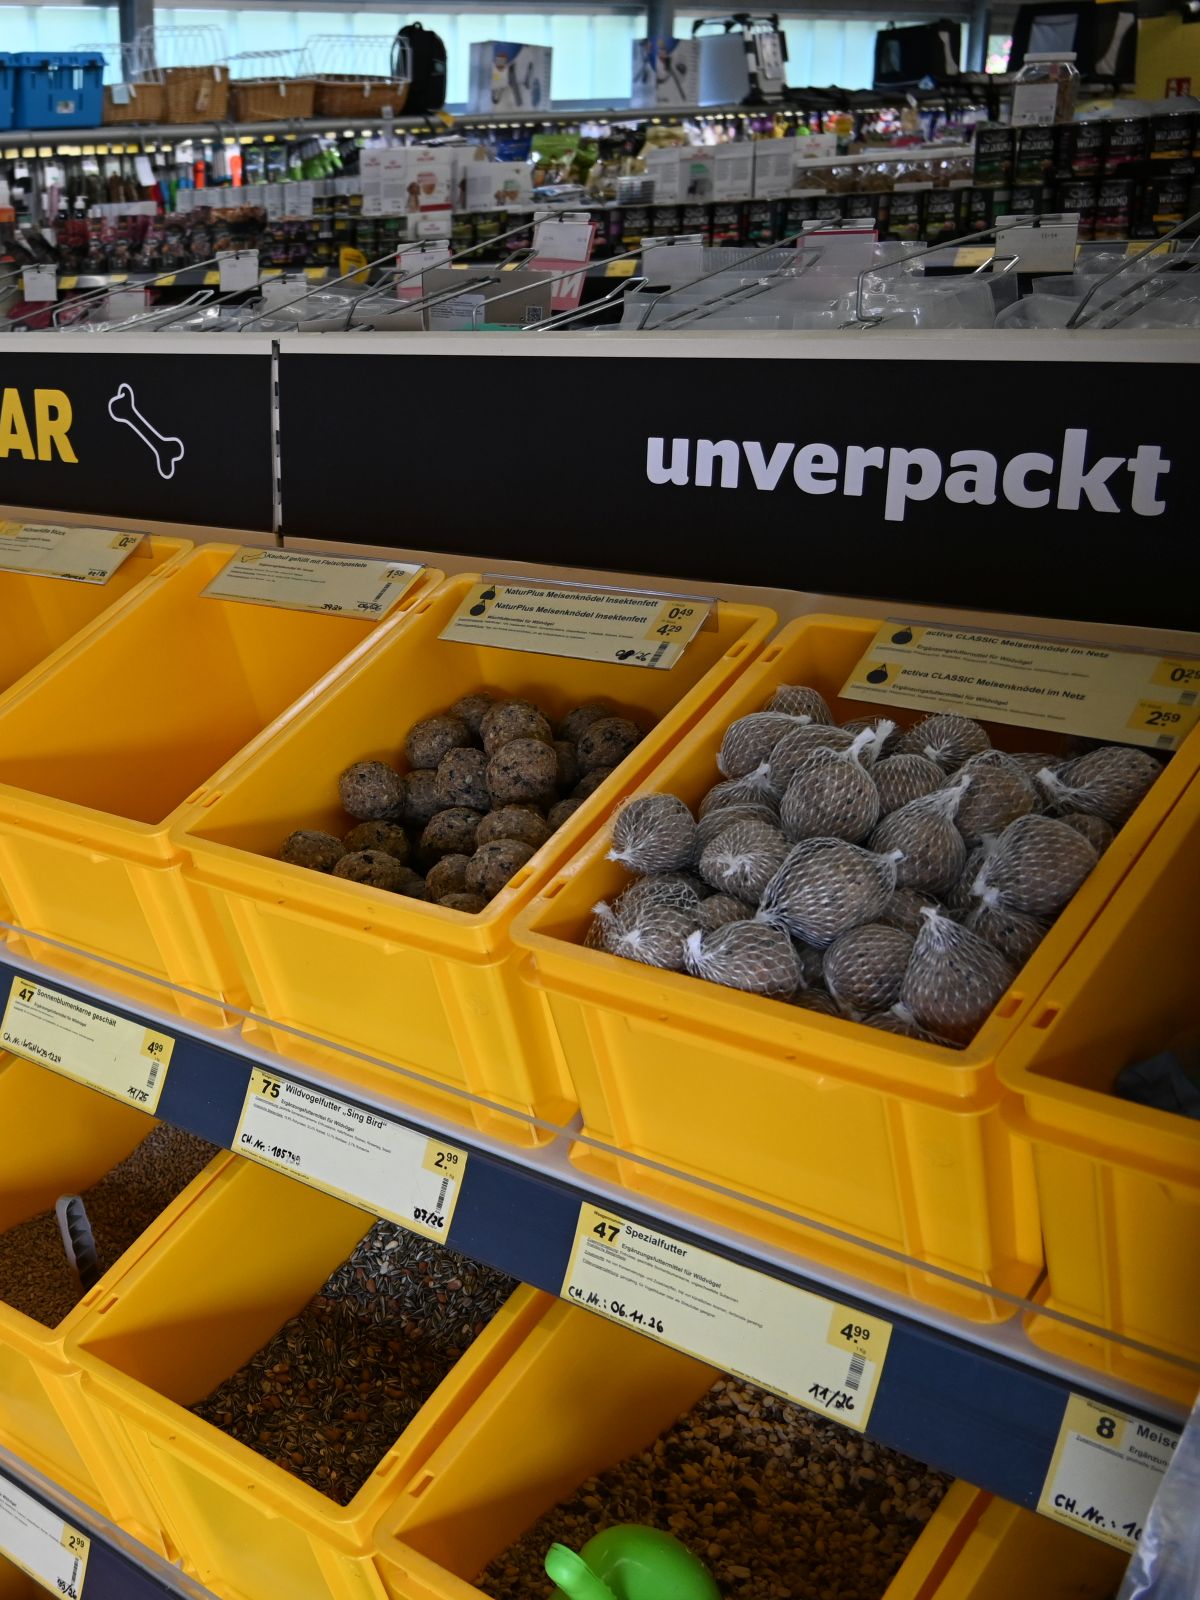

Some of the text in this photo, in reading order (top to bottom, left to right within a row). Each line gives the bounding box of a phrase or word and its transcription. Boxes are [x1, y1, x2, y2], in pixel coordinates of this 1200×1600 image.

[646, 428, 1171, 522] unverpackt
[505, 587, 659, 608] NaturPlus Meisenknödel Insektenfett
[494, 602, 648, 623] NaturPlus Meisenknödel Insektenfett
[668, 607, 694, 620] 0.49
[656, 624, 683, 636] 4.29
[924, 630, 954, 638] activa
[953, 633, 999, 644] CLASSIC
[999, 639, 1070, 653] Meisenknödel
[1085, 650, 1109, 658] Netz
[900, 667, 930, 678] activa
[929, 671, 975, 684] CLASSIC
[974, 678, 1046, 695] Meisenknödel
[1060, 691, 1086, 700] Netz
[1145, 711, 1181, 728] 2.59
[18, 988, 35, 1002] 47
[36, 988, 92, 1017] Sonnenblumenkerne
[91, 1011, 116, 1029] geschält
[147, 1041, 164, 1056] 4.99
[261, 1079, 282, 1098] 75
[284, 1083, 341, 1113] Wildvogelfutter
[434, 1152, 458, 1171] 2.99
[592, 1219, 620, 1244] 47
[623, 1224, 687, 1259] Spezialfutter
[840, 1323, 870, 1344] 4.99
[808, 1383, 855, 1412] 11/26
[1096, 1416, 1117, 1439] 8
[68, 1535, 85, 1552] 2.99
